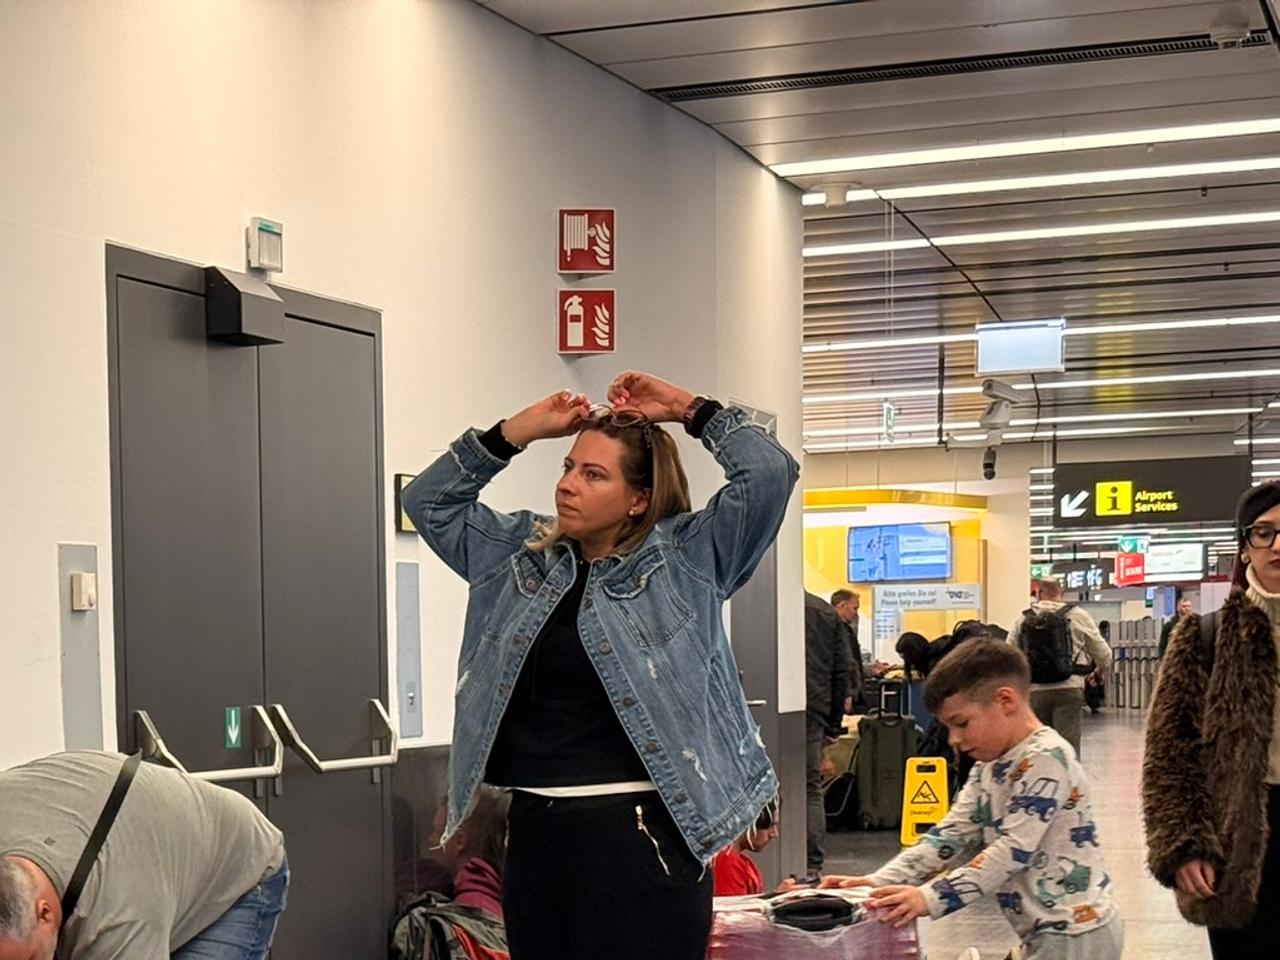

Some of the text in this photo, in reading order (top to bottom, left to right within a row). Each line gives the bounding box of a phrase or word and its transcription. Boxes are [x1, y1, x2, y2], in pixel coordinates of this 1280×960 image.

[1135, 491, 1173, 502] Airport
[1135, 501, 1178, 513] Services
[899, 599, 912, 608] help
